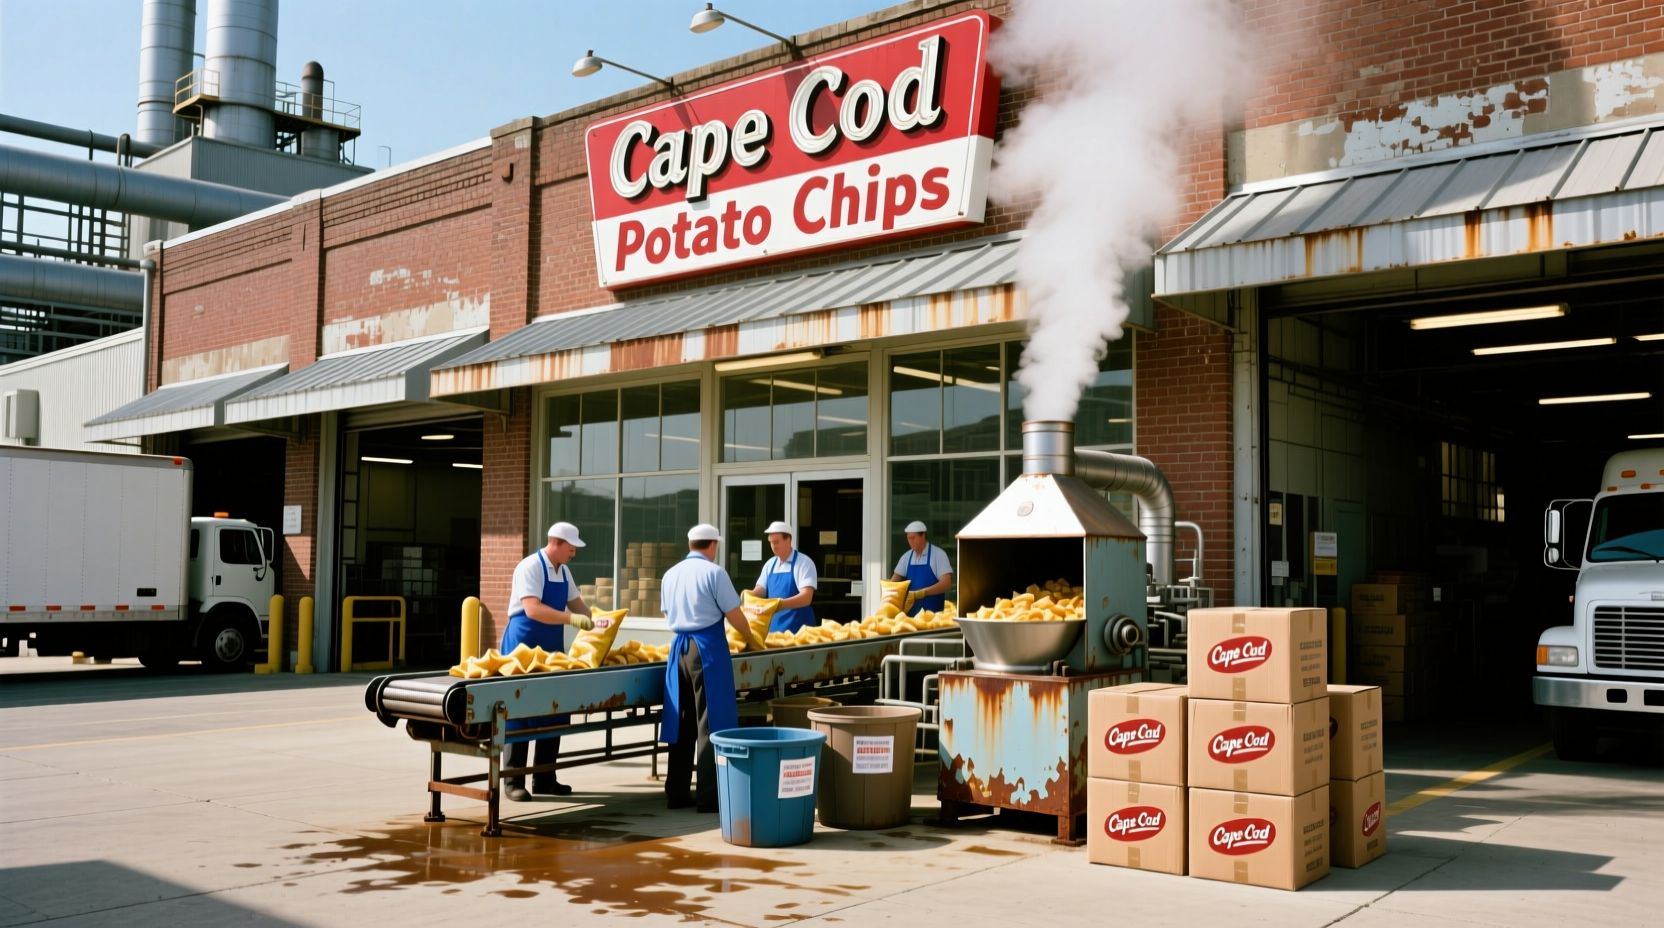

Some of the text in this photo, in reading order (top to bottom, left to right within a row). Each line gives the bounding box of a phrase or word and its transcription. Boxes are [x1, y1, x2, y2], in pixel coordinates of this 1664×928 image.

[609, 34, 945, 201] Cape Cod
[615, 163, 950, 271] Potato Chips
